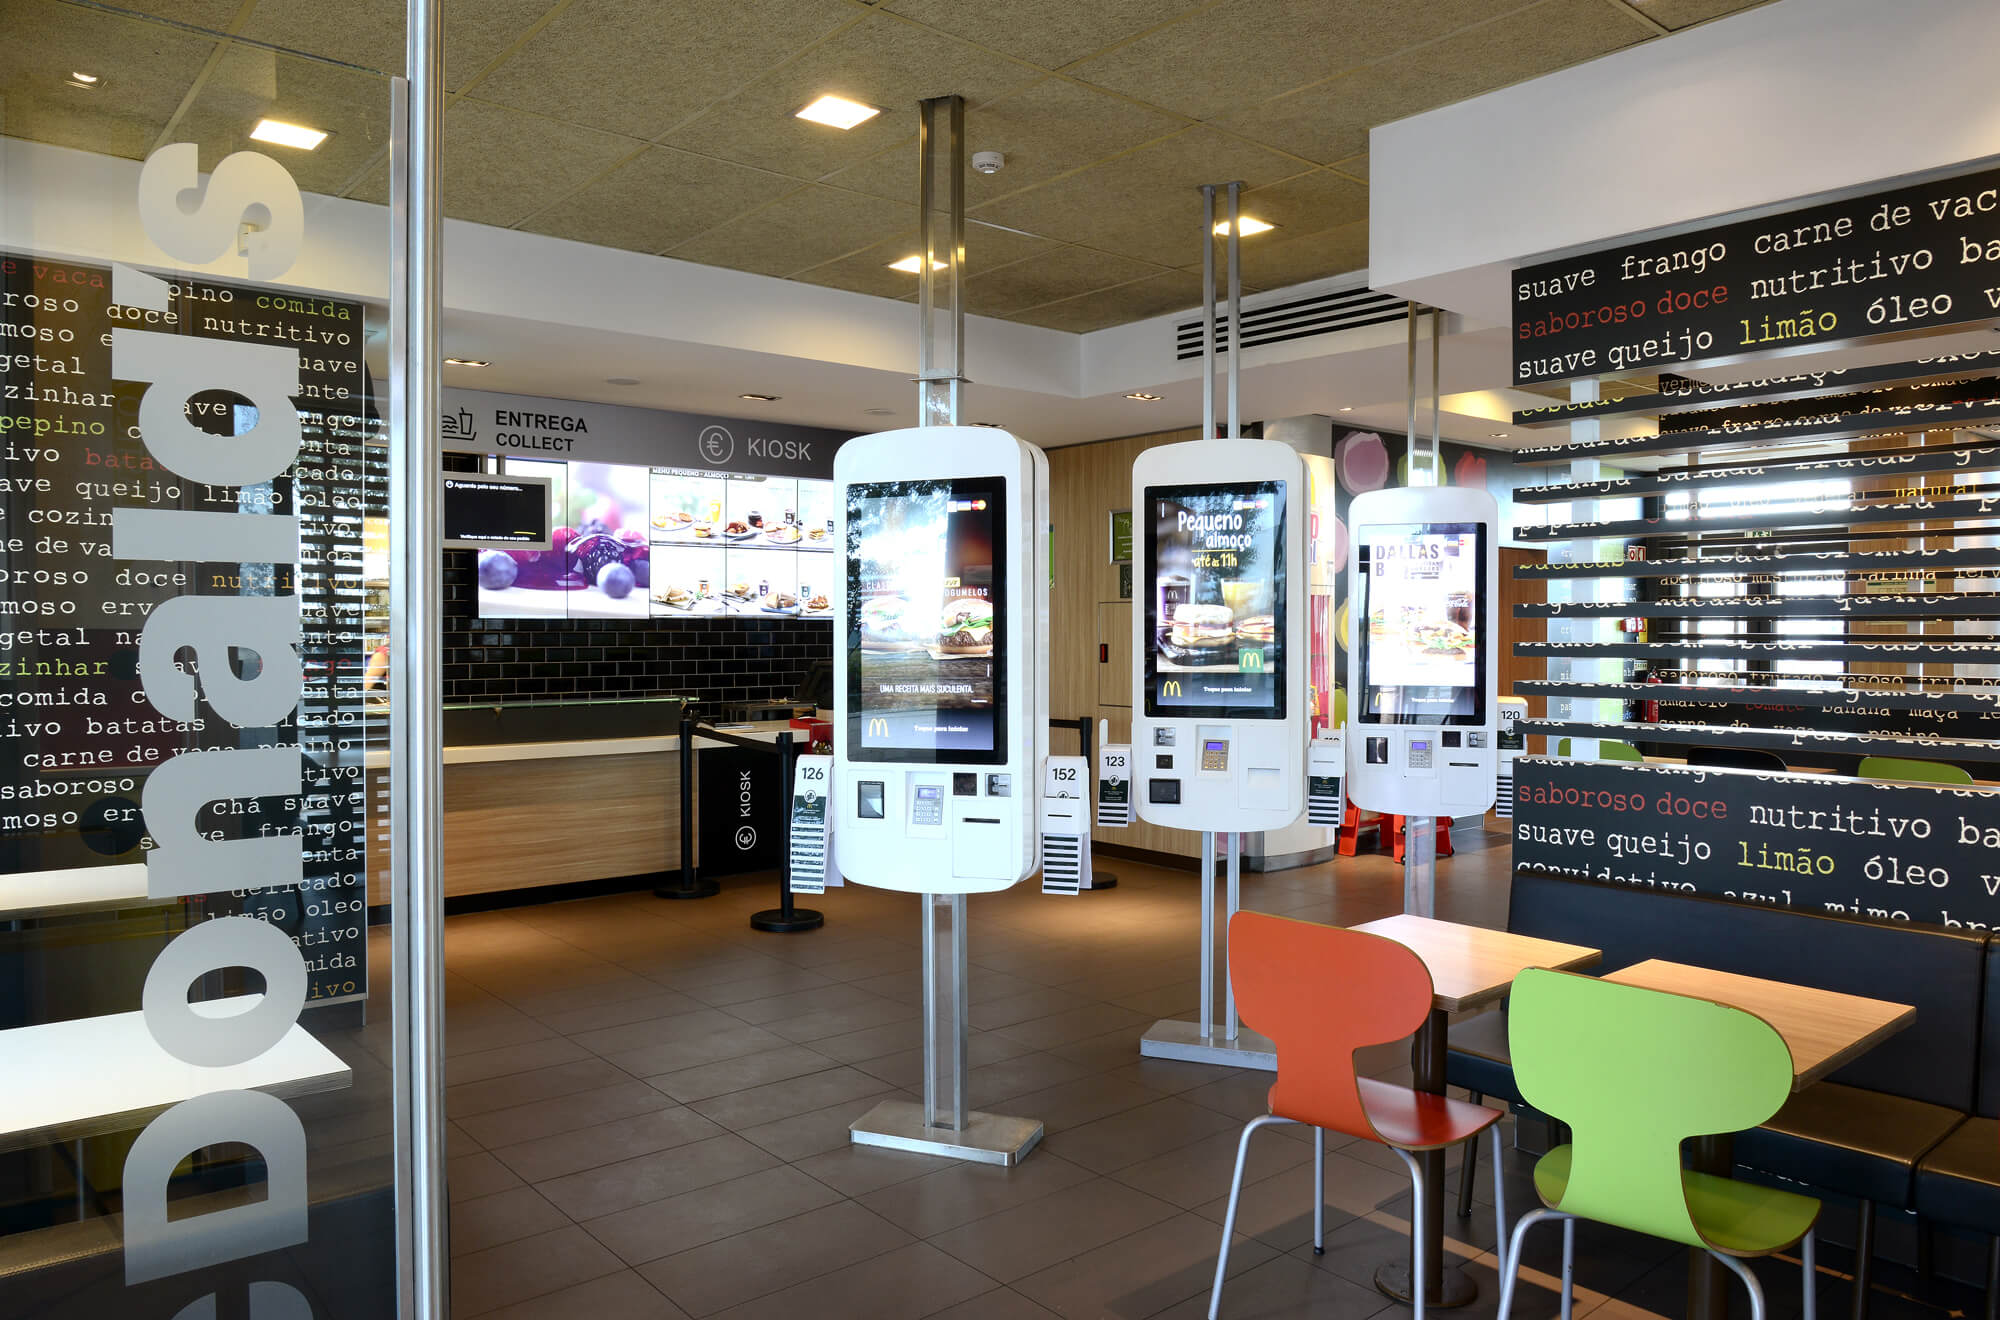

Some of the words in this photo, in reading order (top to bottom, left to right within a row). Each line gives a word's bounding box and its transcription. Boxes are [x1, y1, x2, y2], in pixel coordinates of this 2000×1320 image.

[1518, 267, 1597, 302] suave
[1619, 240, 1728, 282] frango
[1753, 214, 1854, 256] carne
[1869, 203, 1912, 232] de
[1928, 188, 1998, 222] vac
[32, 264, 105, 289] vaca
[256, 295, 351, 321] comida
[1518, 300, 1647, 341] saboroso
[1656, 284, 1729, 315] doce
[1749, 248, 1934, 301] nutritivo
[106, 303, 179, 325] doce
[203, 316, 351, 346] nutritivo
[1518, 346, 1597, 380] suave
[1607, 327, 1714, 372] queijo
[1738, 309, 1838, 347] limão
[1866, 292, 1953, 326] óleo
[0, 415, 106, 437] pepino
[495, 409, 588, 434] ENTREGA
[496, 431, 575, 453] COLLECT
[747, 437, 812, 462] KIOSK
[75, 479, 182, 504] queijo
[203, 484, 284, 505] limão
[1177, 511, 1243, 537] Pequeno
[35, 536, 69, 554] de
[1205, 532, 1252, 552] almoço
[1376, 543, 1440, 560] DALLAS
[1193, 554, 1212, 568] até
[115, 568, 187, 587] doce
[211, 570, 358, 591] nutriivo
[0, 686, 109, 707] comida
[879, 685, 894, 694] UMA
[86, 716, 206, 735] batatas
[1501, 710, 1521, 720] 120
[23, 748, 114, 768] carne
[126, 744, 160, 763] de
[1105, 756, 1126, 767] 123
[801, 767, 824, 780] 126
[1052, 767, 1077, 781] 152
[0, 777, 135, 801] saboroso
[739, 770, 751, 817] KIOSK
[212, 796, 262, 816] chá
[283, 791, 362, 812] suave
[1518, 782, 1646, 812] saboroso
[1656, 791, 1728, 819] doce
[1750, 804, 1932, 839] nutritivo
[258, 819, 353, 839] frango
[1518, 823, 1596, 846] suave
[1606, 831, 1712, 865] queijo
[1737, 840, 1836, 876] limão
[1864, 854, 1950, 888] óleo
[306, 899, 363, 918] oleo
